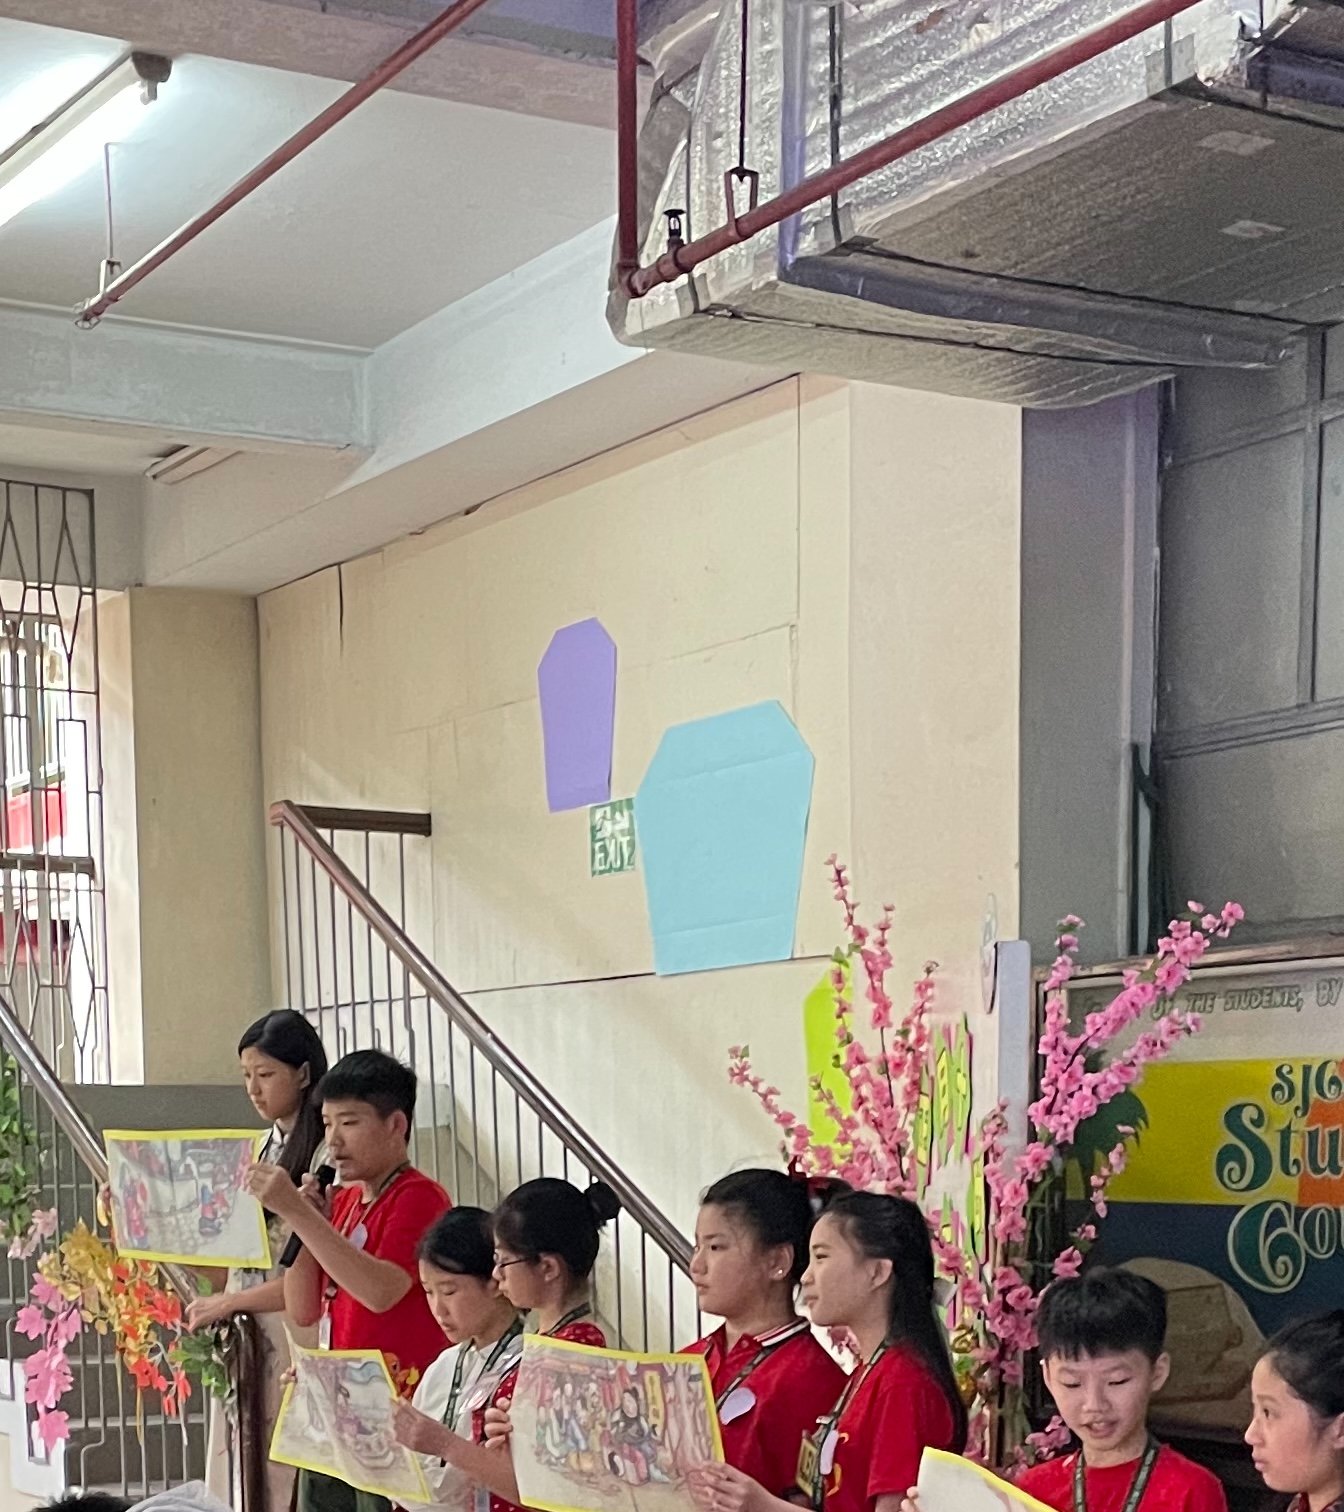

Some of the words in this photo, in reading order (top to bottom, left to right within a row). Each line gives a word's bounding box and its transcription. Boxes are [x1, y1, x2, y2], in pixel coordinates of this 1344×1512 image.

[594, 836, 632, 871] EXIT
[1183, 991, 1218, 1014] THE
[1223, 984, 1305, 1013] STUDENTS,
[1315, 977, 1343, 1008] BY
